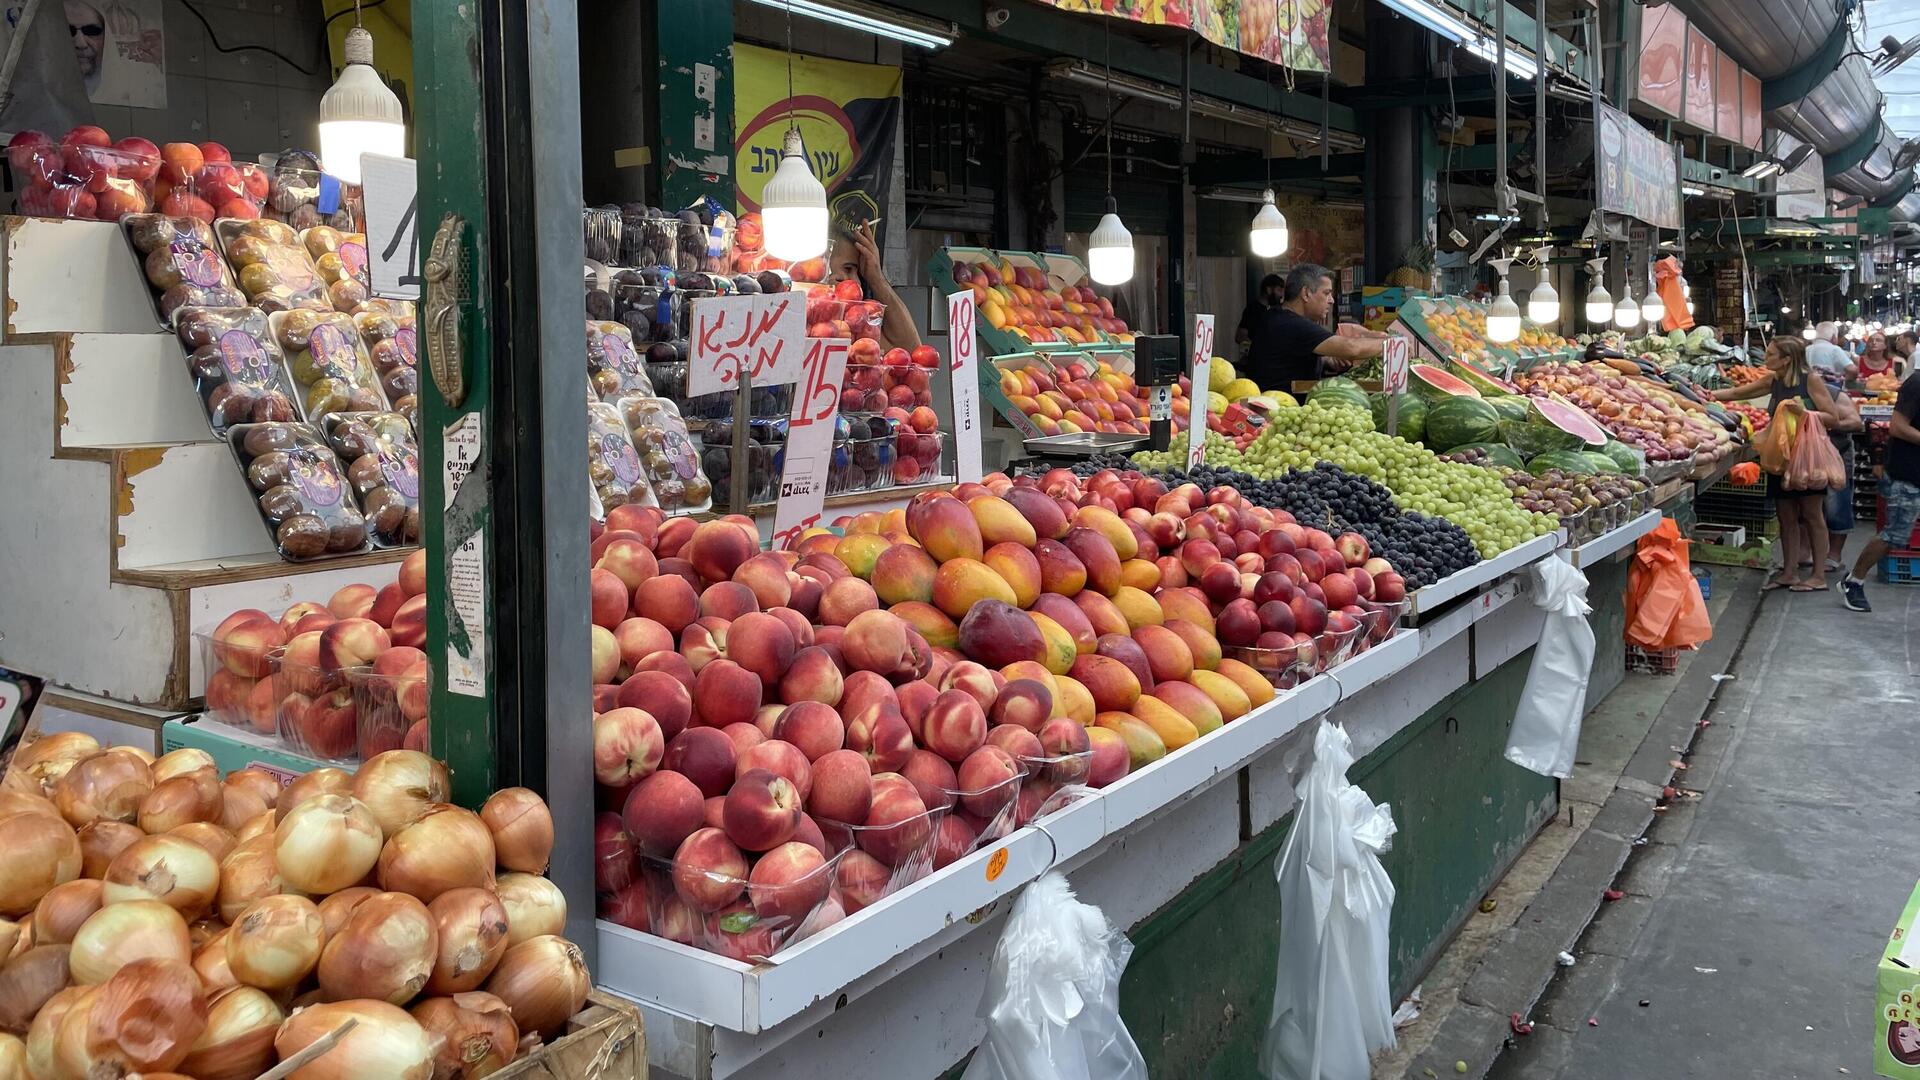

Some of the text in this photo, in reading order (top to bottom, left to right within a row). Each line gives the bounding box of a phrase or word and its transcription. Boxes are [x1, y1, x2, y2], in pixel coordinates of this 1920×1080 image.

[814, 150, 839, 182] עין
[950, 297, 972, 371] 18
[1195, 320, 1213, 366] 20
[790, 339, 848, 427] 15
[1386, 337, 1406, 391] 12
[458, 444, 467, 460] אל
